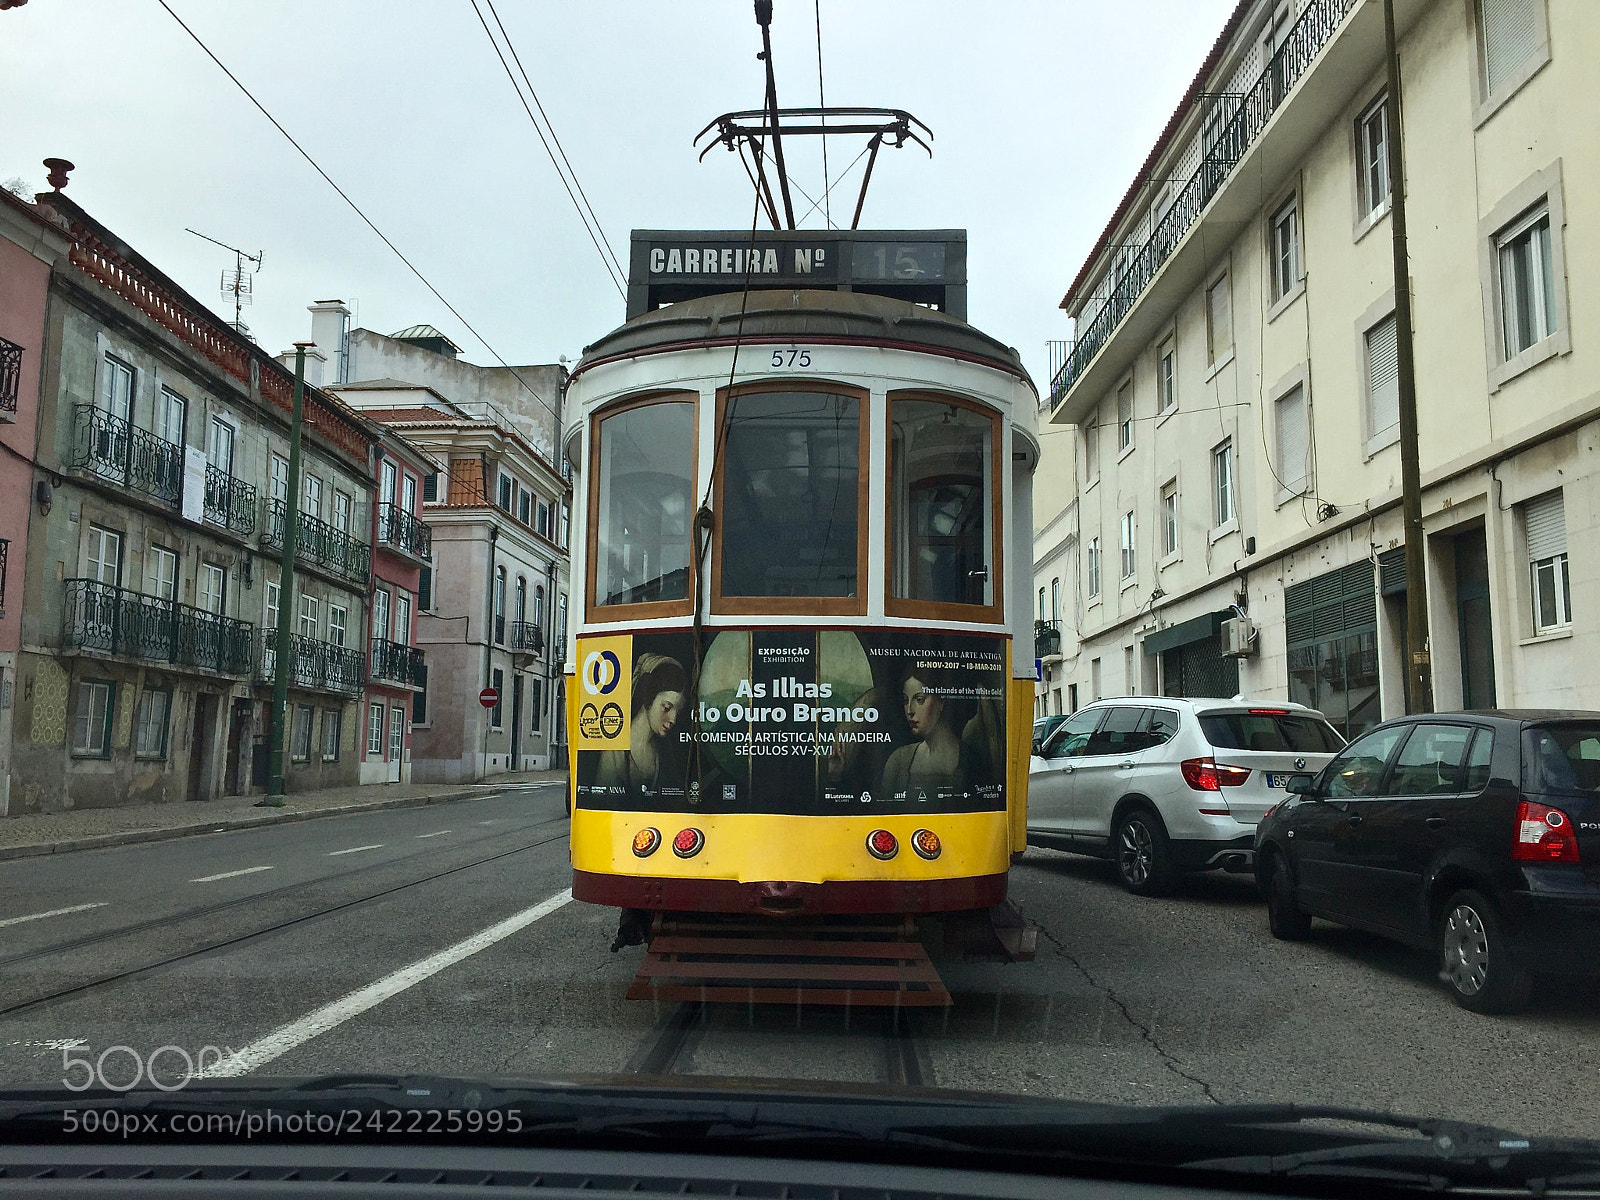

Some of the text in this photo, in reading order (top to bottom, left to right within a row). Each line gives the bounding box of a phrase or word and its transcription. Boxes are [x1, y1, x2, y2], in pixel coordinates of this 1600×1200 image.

[650, 248, 778, 273] CARREIRA
[874, 246, 920, 279] 15
[771, 350, 811, 367] 575
[758, 647, 810, 656] EXPOSIÇÃO
[869, 648, 1002, 661] MUSEU NACIONAL DE ARTE ANTIGA
[736, 676, 833, 698] As Ilhas
[922, 686, 935, 694] The
[935, 686, 958, 694] Islands
[958, 686, 965, 694] of
[726, 703, 787, 722] Ouro
[793, 703, 879, 722] Branco
[754, 730, 815, 743] ARTÍSTICA
[818, 732, 836, 742] NA
[838, 732, 892, 743] MADEIRA
[734, 743, 789, 756] SÉCULOS
